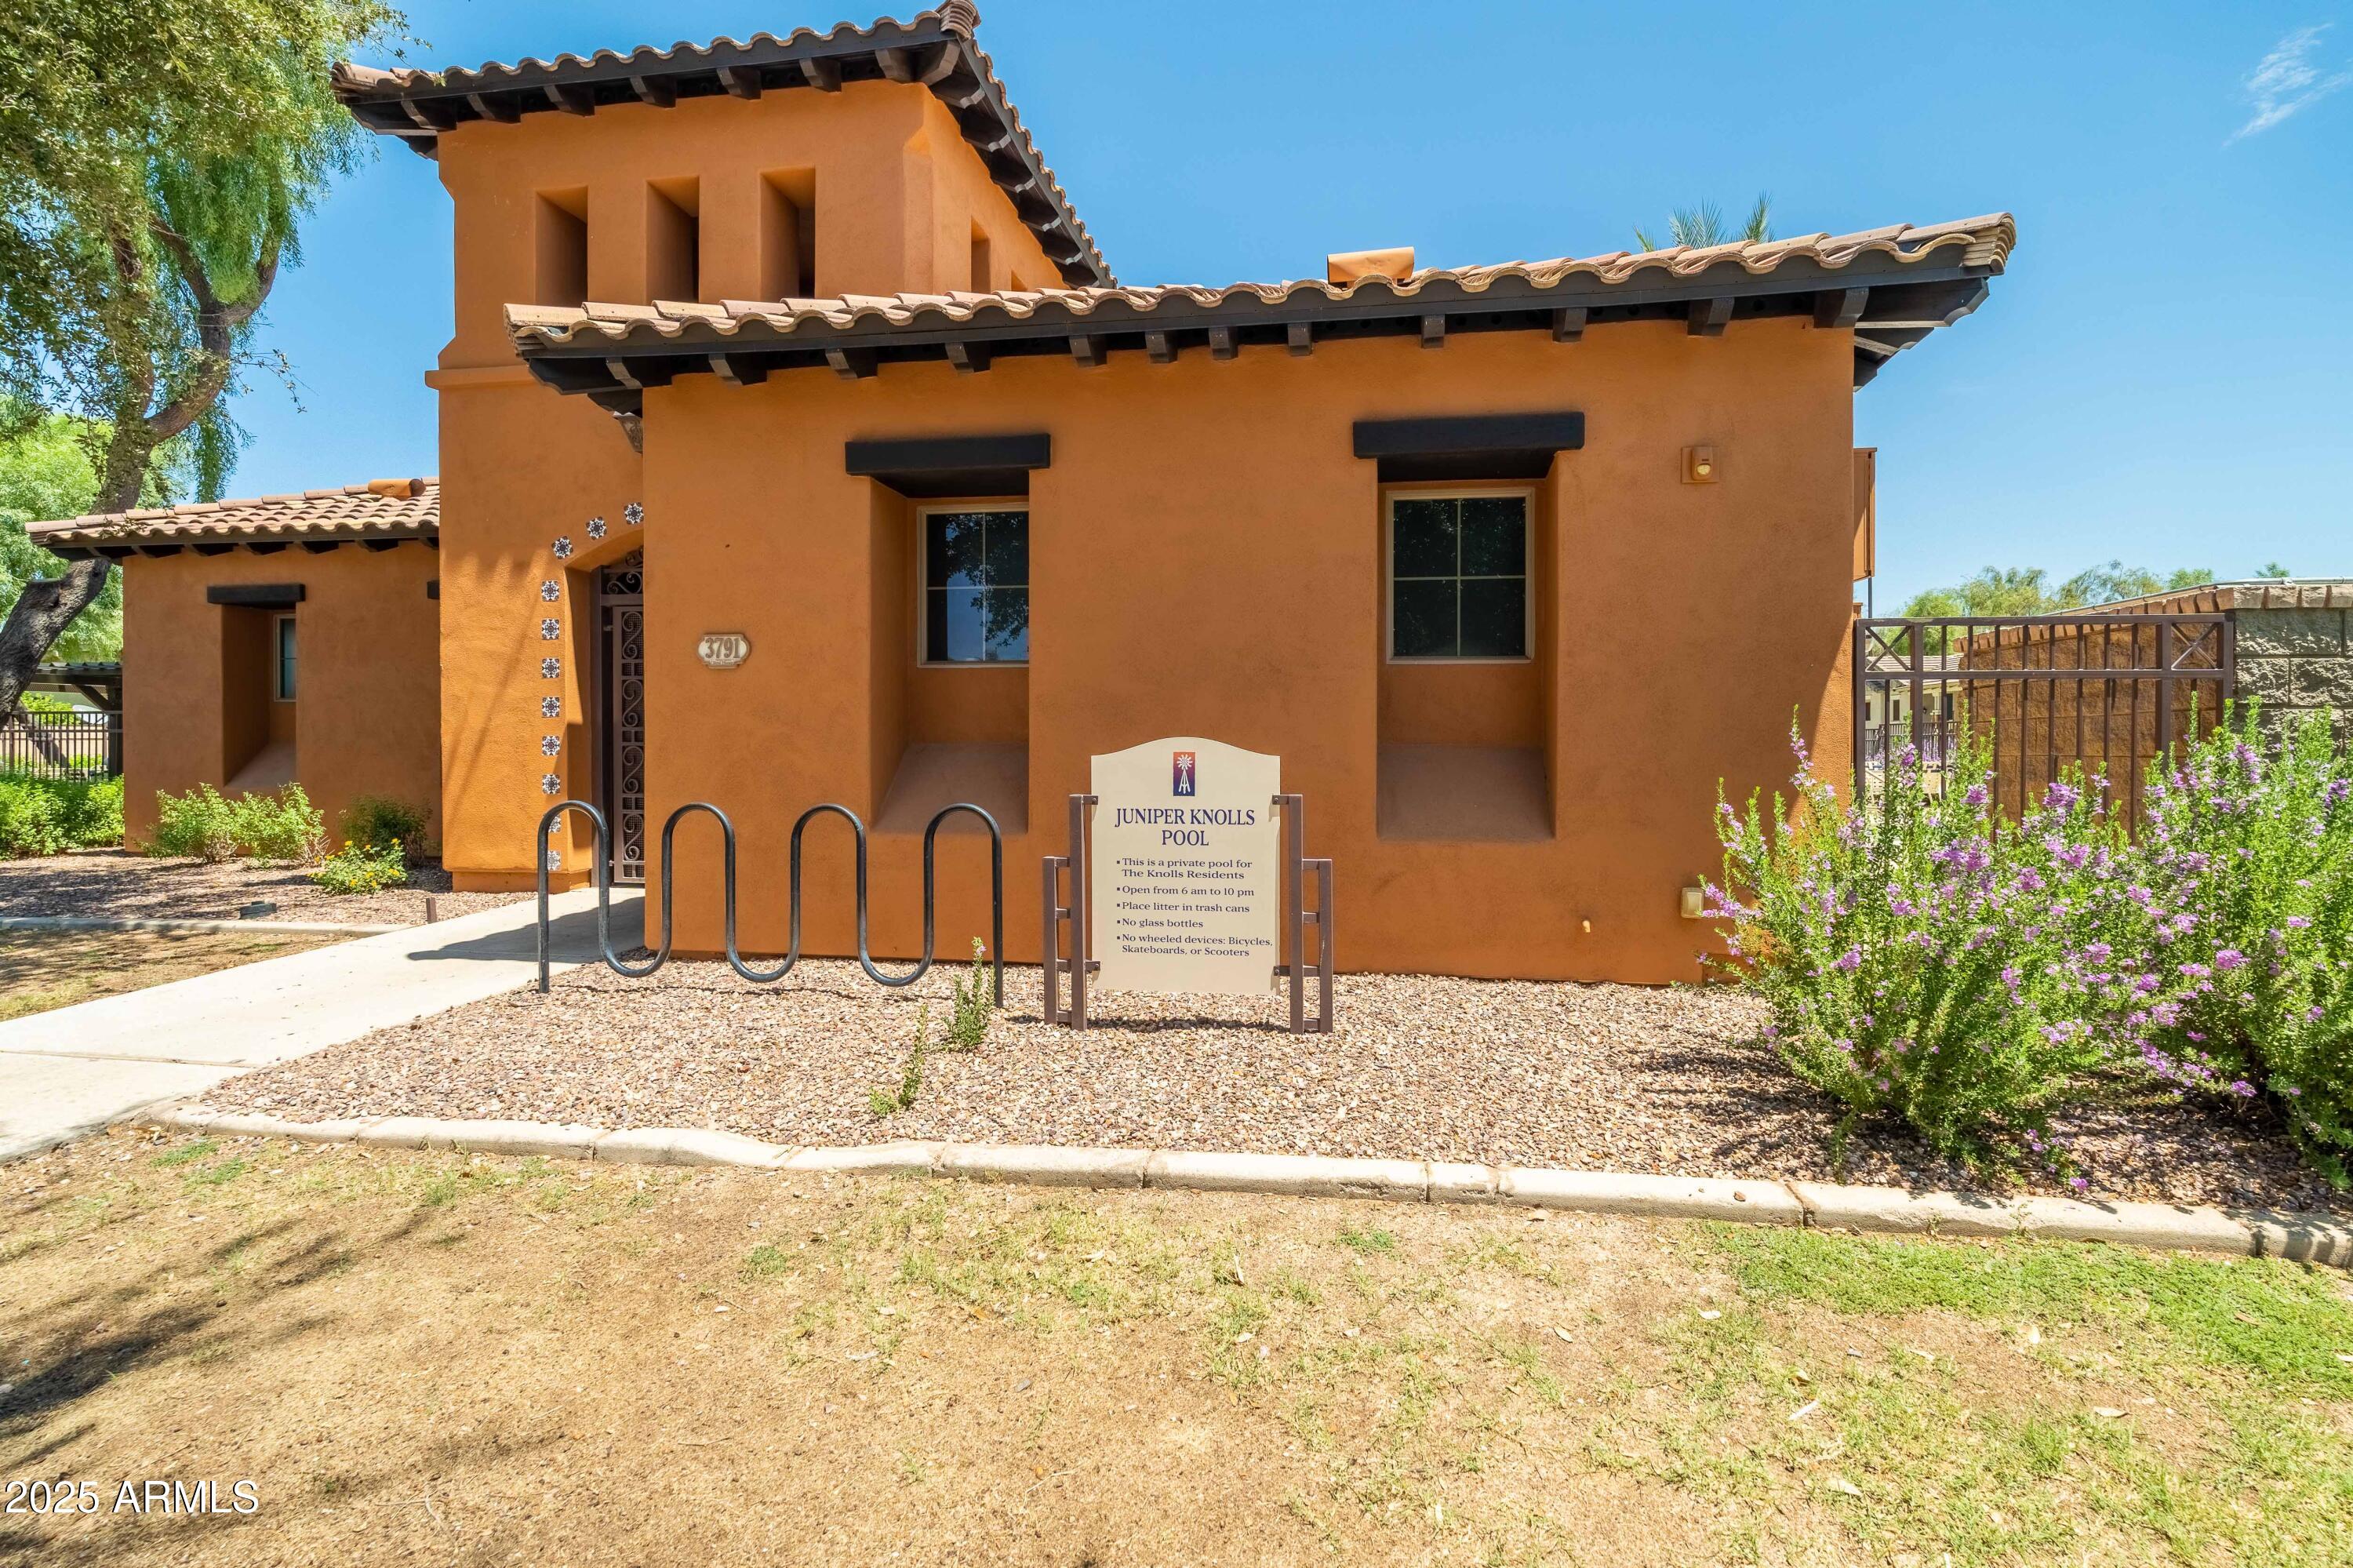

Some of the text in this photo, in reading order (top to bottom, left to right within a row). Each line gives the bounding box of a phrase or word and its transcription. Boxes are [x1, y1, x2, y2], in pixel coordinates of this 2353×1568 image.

[704, 637, 741, 659] 3791
[1114, 808, 1255, 828] JUNIPER KNOLLS
[1162, 829, 1209, 846] POOL
[1122, 857, 1144, 866] This
[1147, 858, 1156, 867] is
[1167, 859, 1206, 868] private
[1208, 859, 1233, 869] pool
[1235, 859, 1253, 868] for
[1122, 868, 1245, 879] The Knolls Residents
[1122, 885, 1151, 896] Open
[1153, 886, 1179, 895] from
[1181, 886, 1188, 895] 6
[1224, 887, 1235, 896] 10
[1237, 890, 1255, 898] pm
[1122, 901, 1151, 911] Place
[1153, 902, 1180, 911] litter
[1182, 903, 1193, 911] in
[1195, 903, 1223, 912] trash
[1122, 918, 1204, 929] No glass bottles
[1122, 933, 1273, 948] No wheeled devices: Bicycles,
[1122, 944, 1187, 955] Skateboards,
[1204, 947, 1249, 957] Scooters
